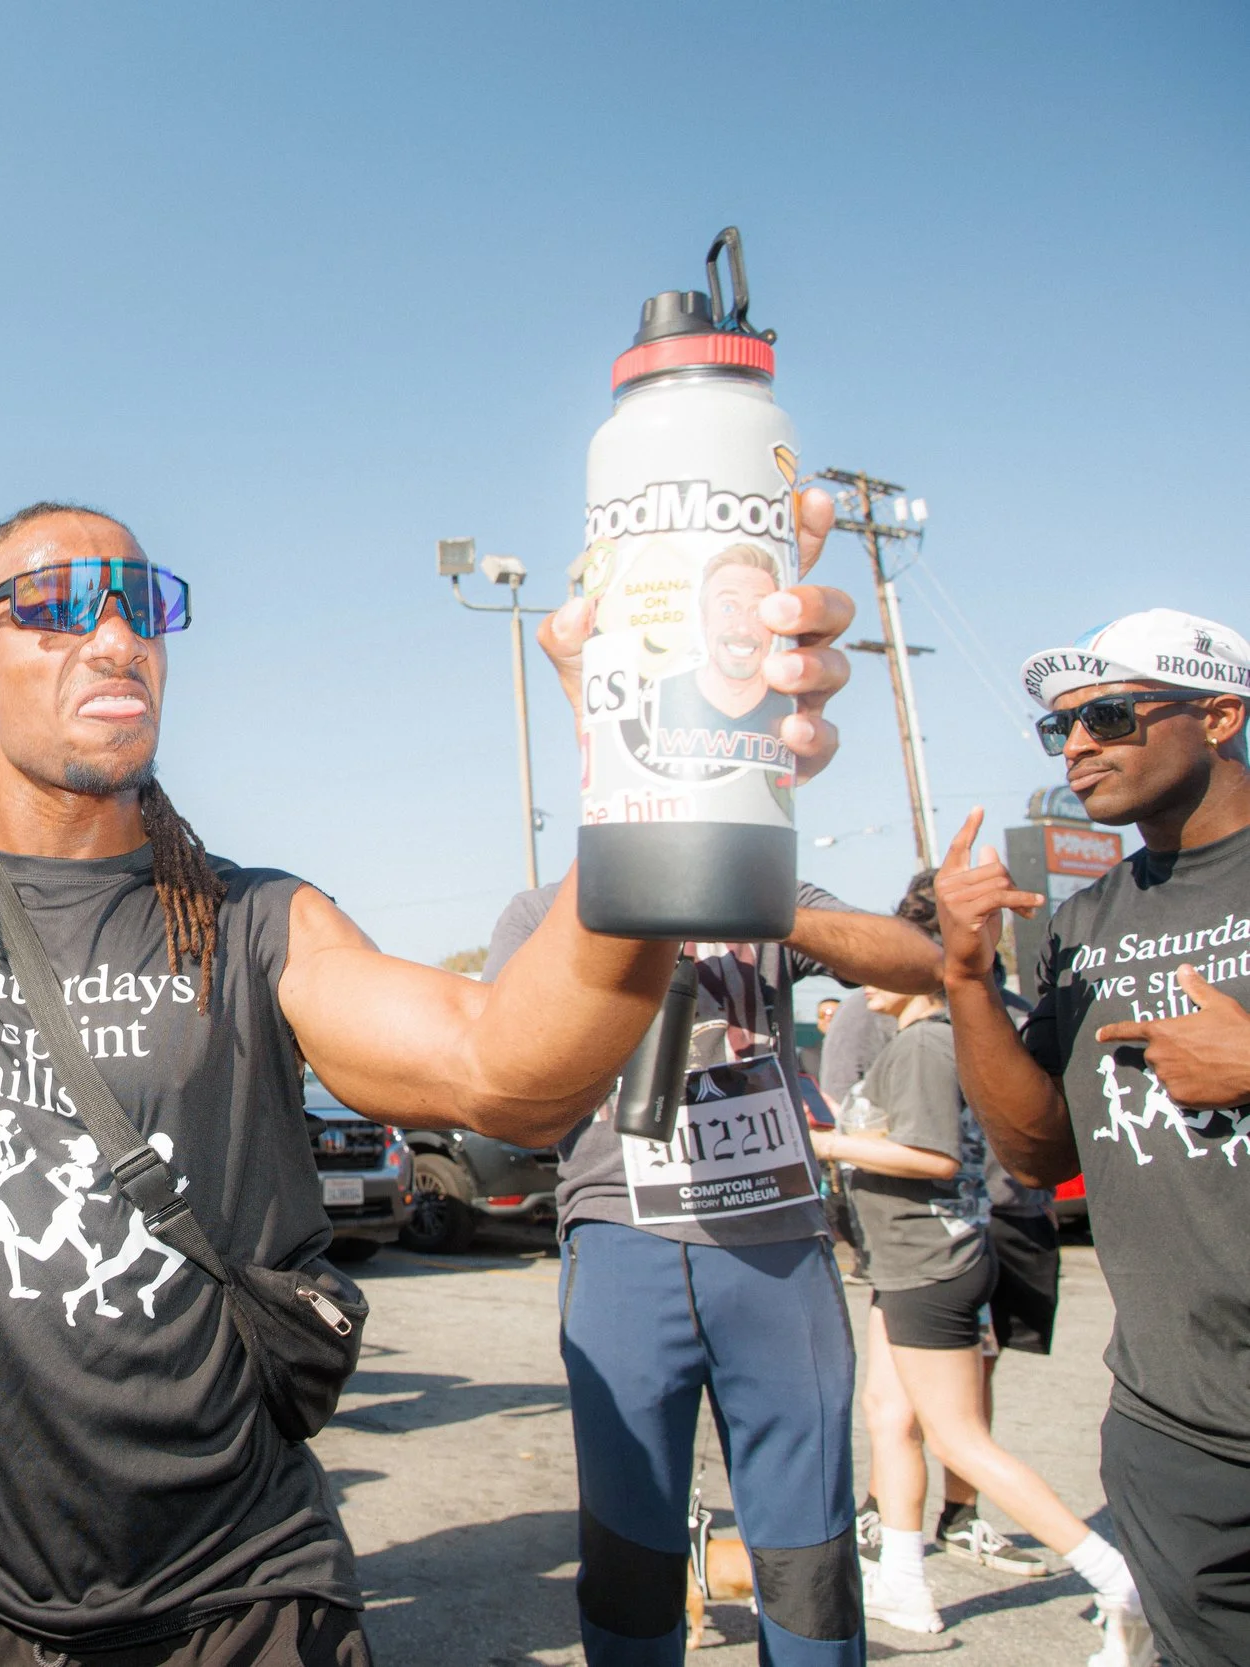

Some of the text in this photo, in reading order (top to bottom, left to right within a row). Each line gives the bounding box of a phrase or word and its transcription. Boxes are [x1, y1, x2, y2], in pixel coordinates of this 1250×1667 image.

[586, 479, 792, 543] oodMood
[644, 597, 668, 609] ON
[630, 611, 684, 627] BOARD
[1025, 655, 1110, 700] BROOKLYN
[1071, 943, 1107, 974] On
[1091, 975, 1136, 1001] we
[1131, 995, 1201, 1023] hill
[1, 1015, 151, 1061] spint
[679, 1178, 752, 1199] COMPTON
[681, 1186, 780, 1210] HISTORY MUSEUM
